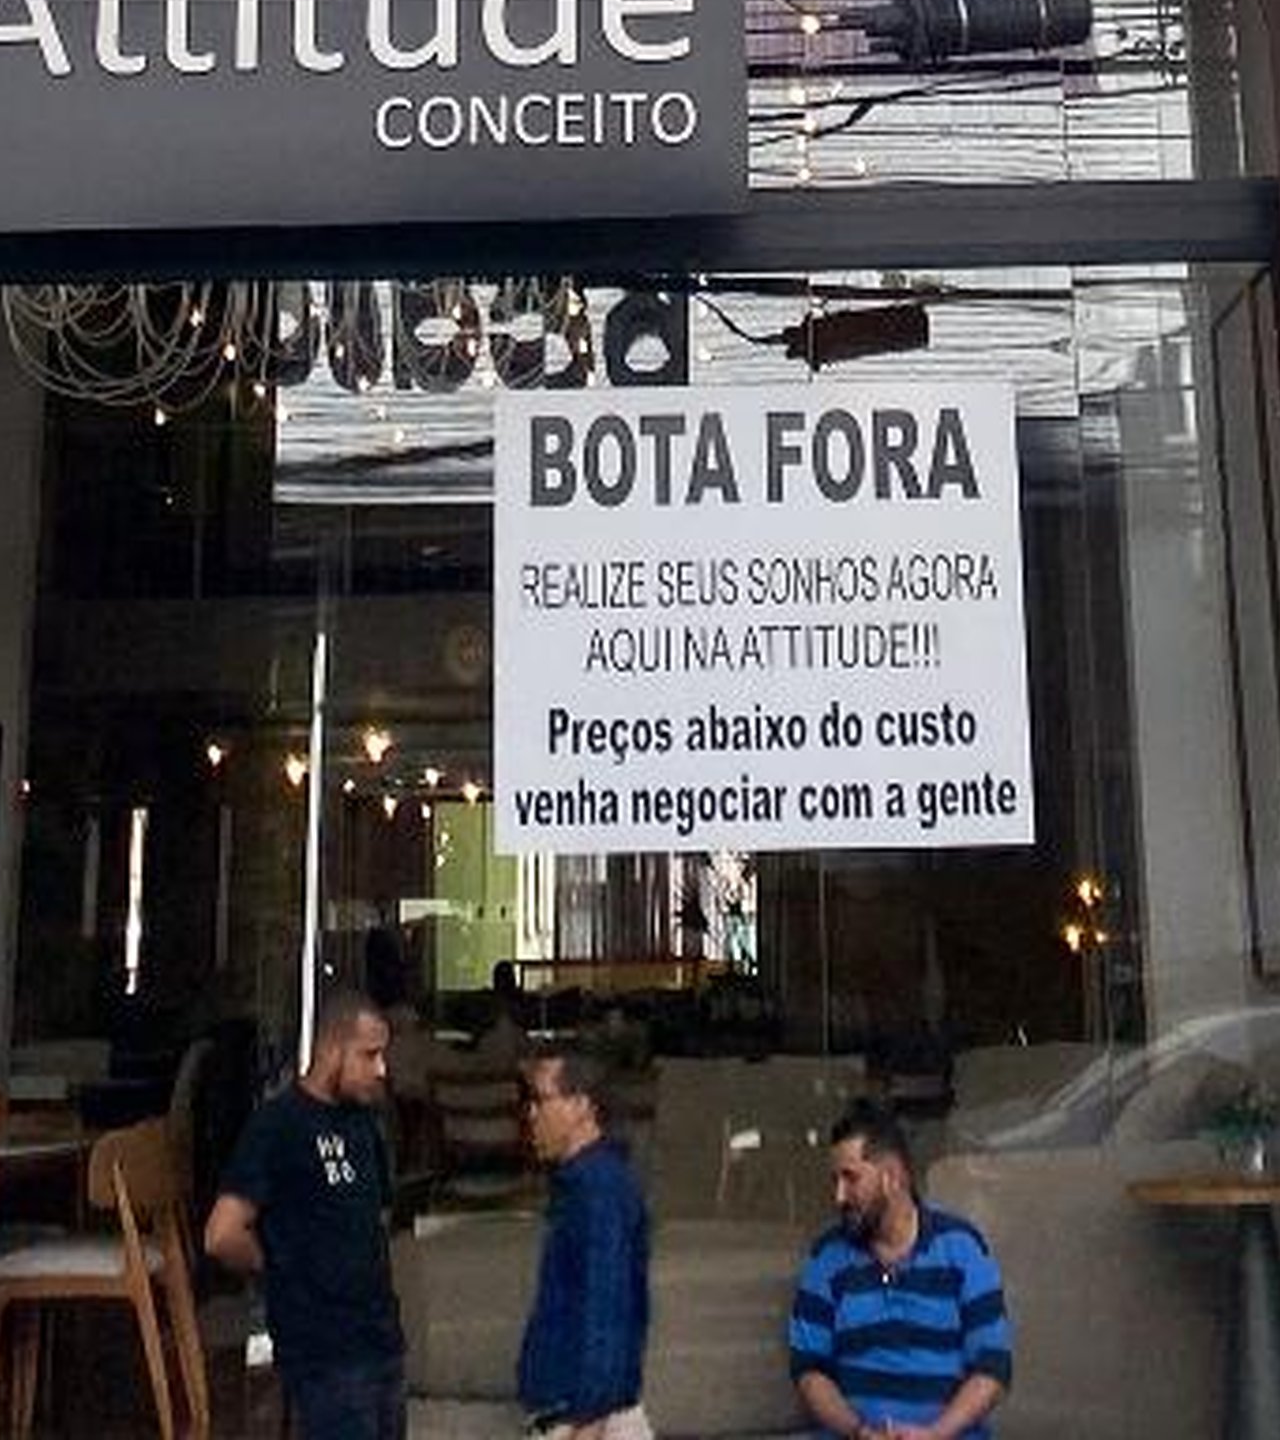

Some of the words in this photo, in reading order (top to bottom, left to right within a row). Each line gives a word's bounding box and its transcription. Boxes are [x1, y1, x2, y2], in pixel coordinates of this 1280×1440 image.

[376, 91, 697, 148] CONCEITO
[528, 413, 741, 507] BOTA
[764, 409, 982, 503] FORA
[522, 561, 646, 609] REALIZE
[656, 560, 739, 606] SEUS
[746, 557, 880, 605] SONHOS
[886, 554, 998, 602] AGORA
[585, 628, 672, 673] AQUI
[682, 626, 733, 671] NA
[739, 623, 942, 671] ATTITUDE!!!
[547, 707, 673, 766] Preços
[685, 704, 808, 752] abaixo
[819, 701, 865, 748] do
[875, 703, 977, 747] custo
[515, 778, 619, 826] venha
[631, 774, 789, 836] negociar
[799, 781, 873, 820] com
[886, 782, 907, 818] a
[919, 772, 1018, 829] gente
